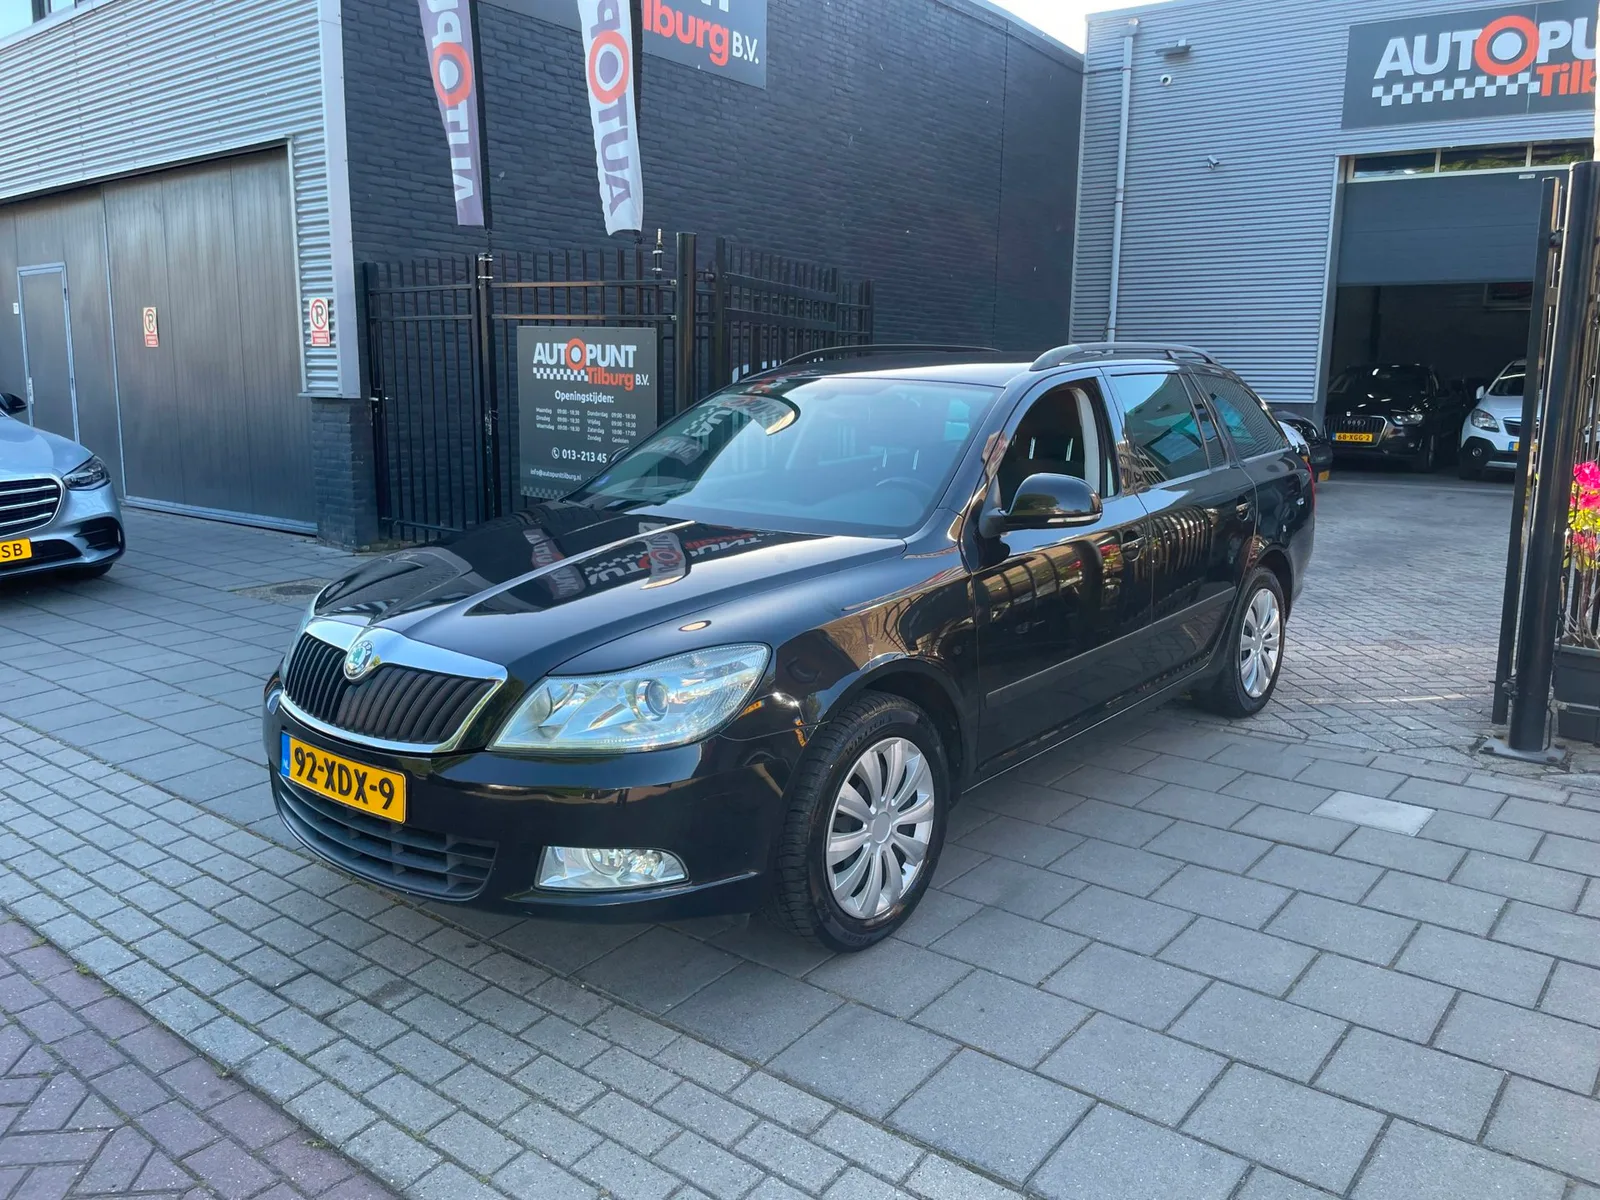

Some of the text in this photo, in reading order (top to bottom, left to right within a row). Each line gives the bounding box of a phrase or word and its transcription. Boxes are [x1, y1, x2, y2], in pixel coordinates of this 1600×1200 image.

[642, 0, 760, 67] lburg B.V.
[533, 338, 637, 369] AUTOPUNT
[586, 366, 650, 392] Tilburg B.V.
[554, 390, 615, 404] Openingstijden:
[1, 543, 23, 559] SB
[293, 746, 395, 811] 92-XDX-9
